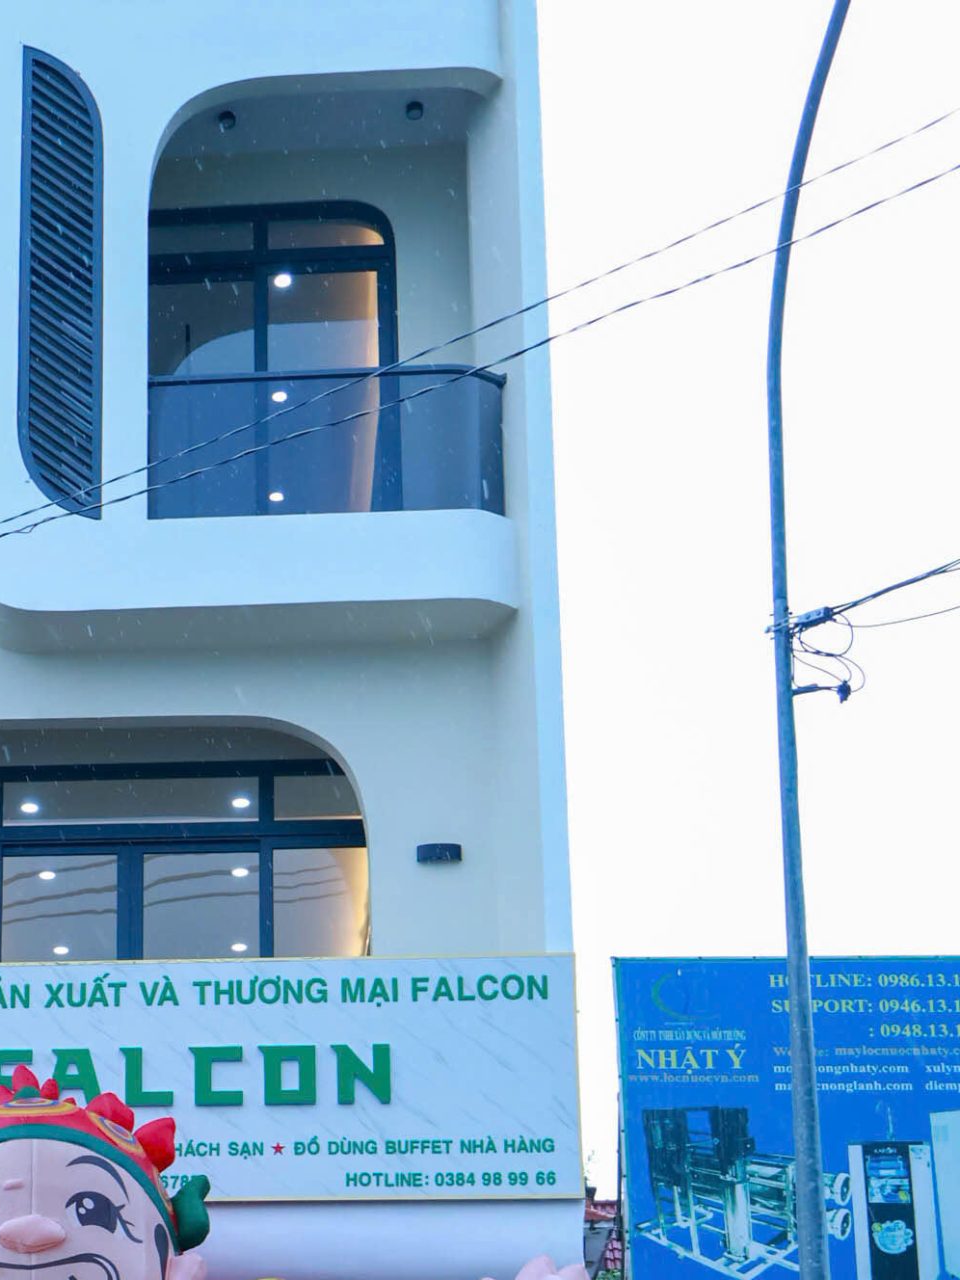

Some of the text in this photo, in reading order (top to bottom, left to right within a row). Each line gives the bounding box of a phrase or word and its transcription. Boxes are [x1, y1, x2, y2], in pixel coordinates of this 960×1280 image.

[45, 973, 126, 1008] XUẤT
[139, 975, 179, 1007] VÀ
[193, 974, 328, 1005] THƯƠNG
[341, 976, 398, 1008] MẠI
[412, 974, 549, 1002] FALCON
[636, 1043, 746, 1074] NHẬT Ý
[175, 1139, 220, 1157] HÁCH
[228, 1141, 263, 1160] SẠN
[328, 1136, 378, 1155] DÙNG
[386, 1140, 453, 1156] BUFFET
[460, 1136, 497, 1155] NHÀ
[504, 1136, 555, 1154] HÀNG
[345, 1171, 429, 1188] HOTLINE:
[481, 1171, 503, 1187] 98
[508, 1171, 529, 1187] 99
[535, 1171, 557, 1187] 66
